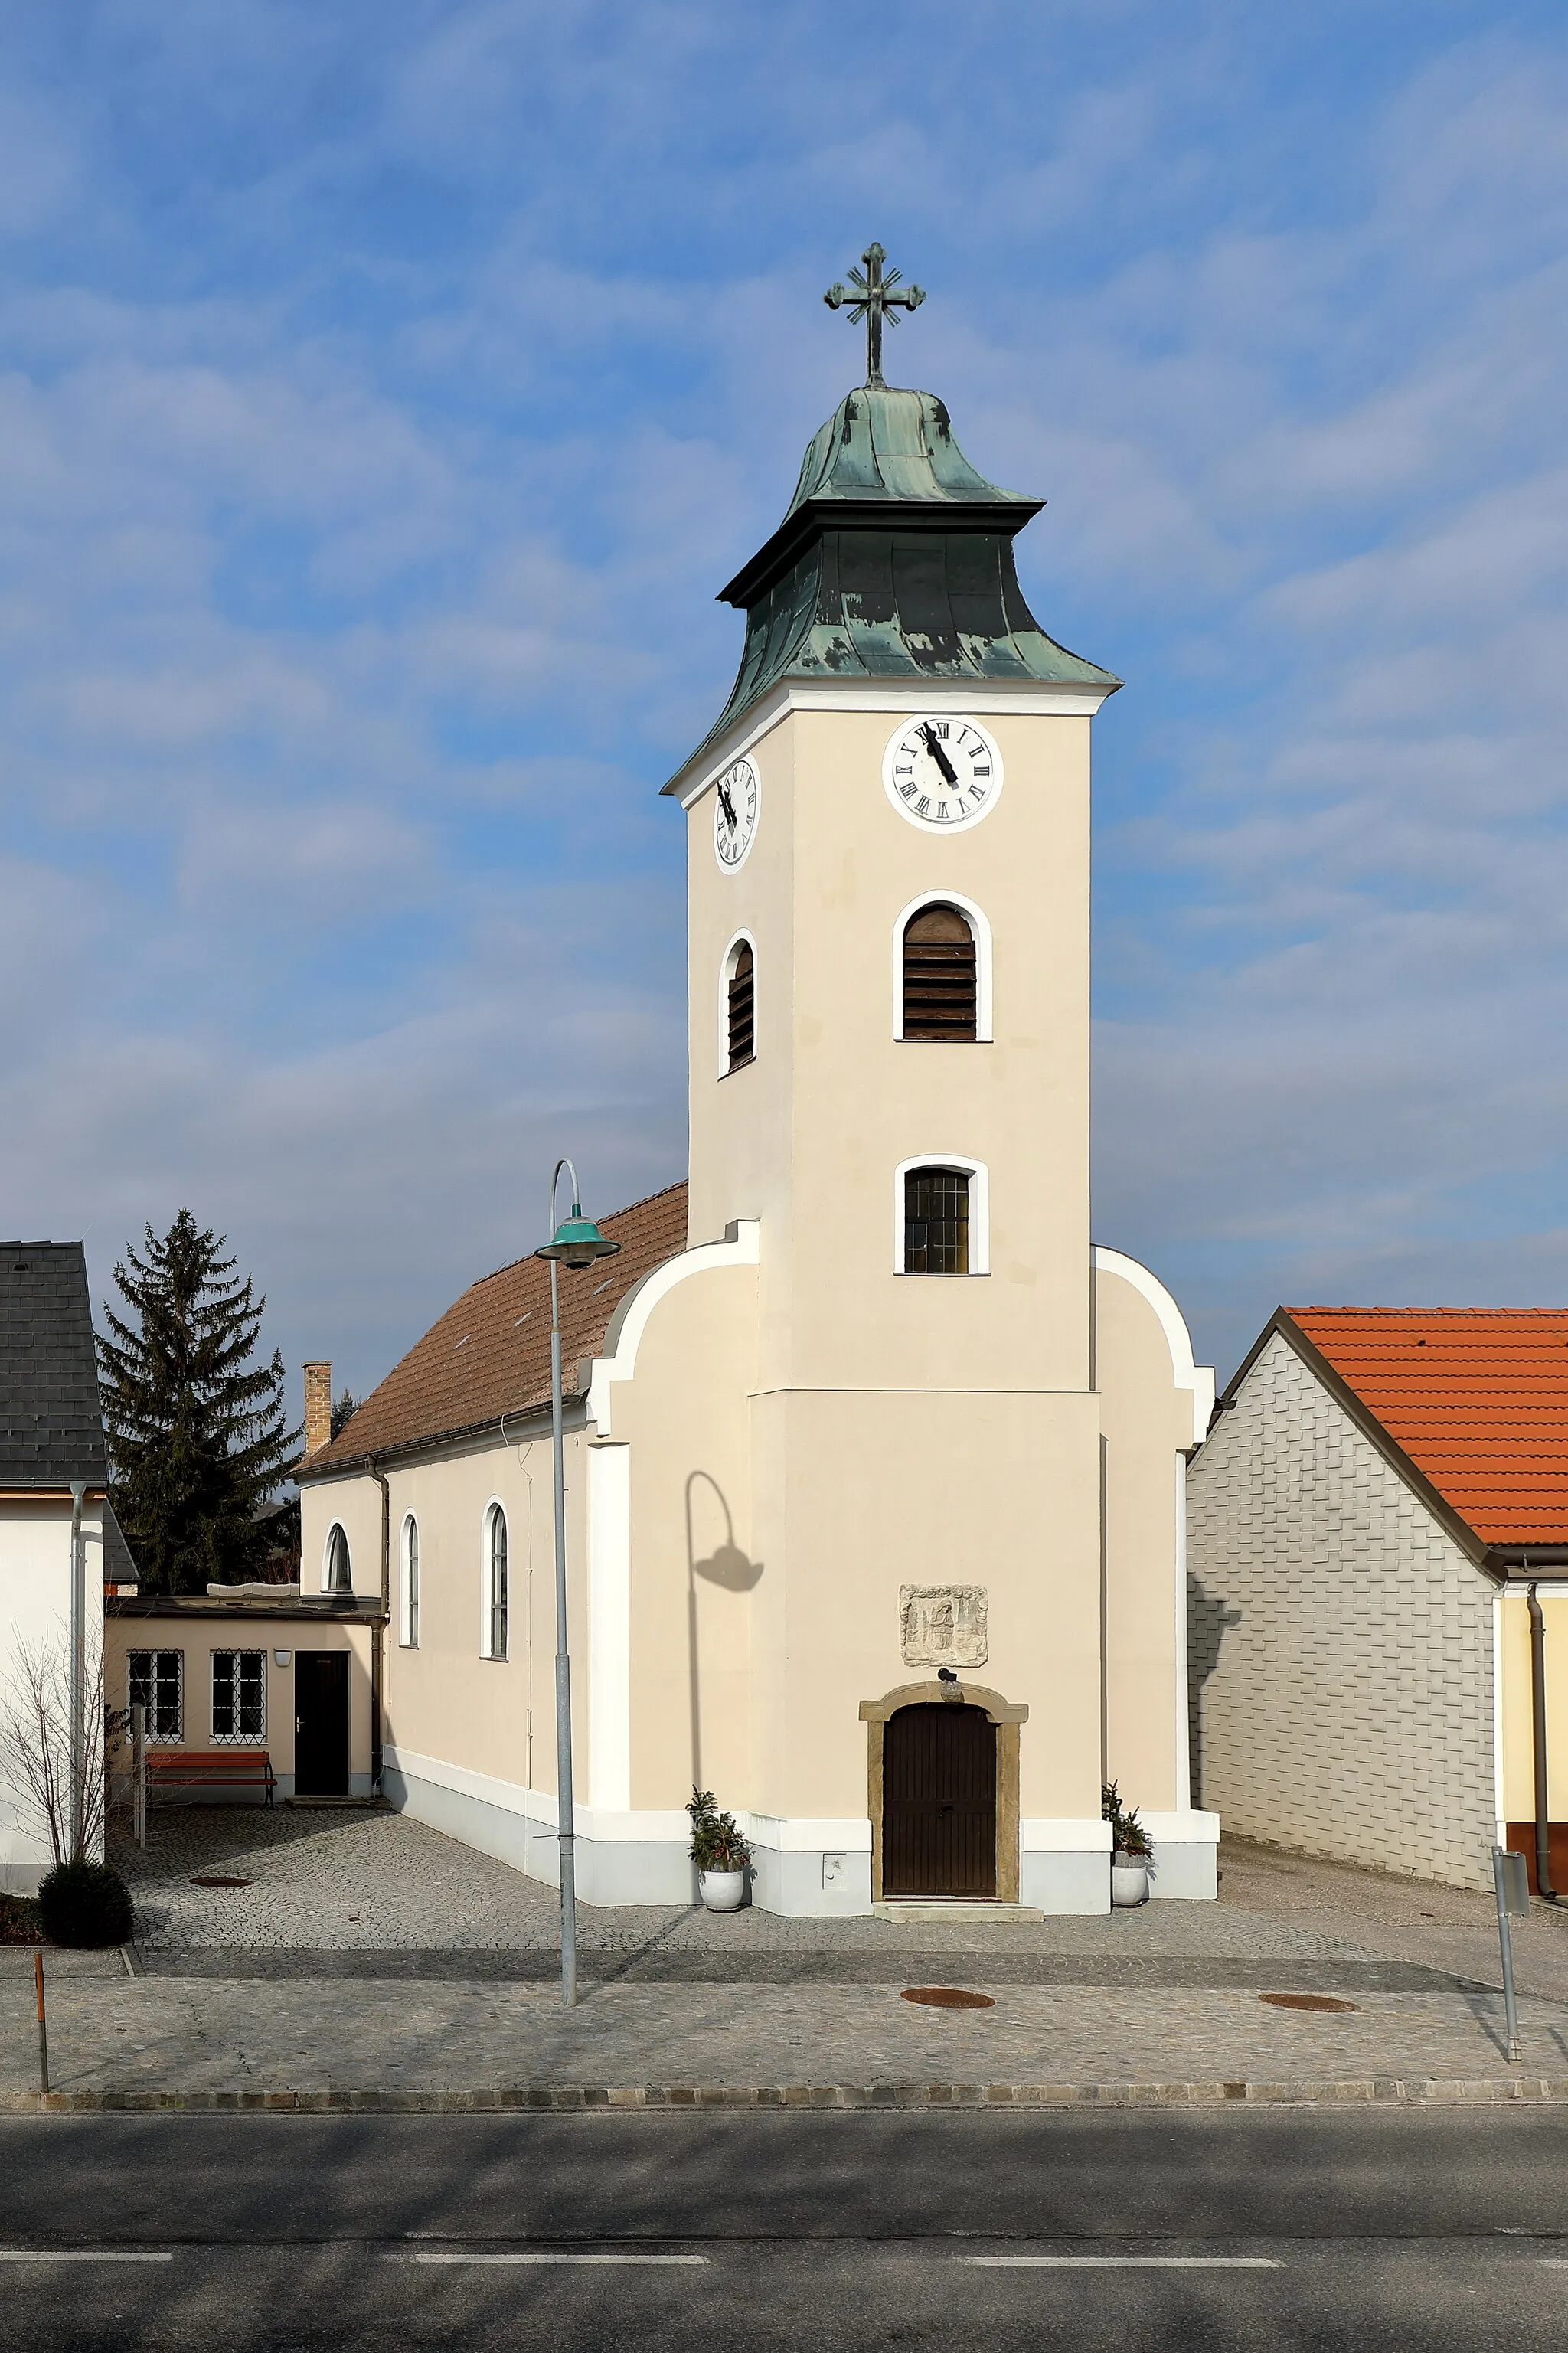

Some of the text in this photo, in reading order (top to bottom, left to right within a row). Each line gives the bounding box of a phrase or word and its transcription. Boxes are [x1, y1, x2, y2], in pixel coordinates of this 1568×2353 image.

[936, 723, 950, 739] XII
[956, 728, 969, 744] I
[900, 743, 918, 758] X
[968, 744, 985, 759] II
[896, 765, 913, 775] IX
[974, 766, 989, 776] III
[900, 782, 919, 801] VIII
[968, 783, 986, 802] IV
[914, 794, 932, 815] VII
[936, 801, 950, 818] VI
[956, 796, 972, 815] V
